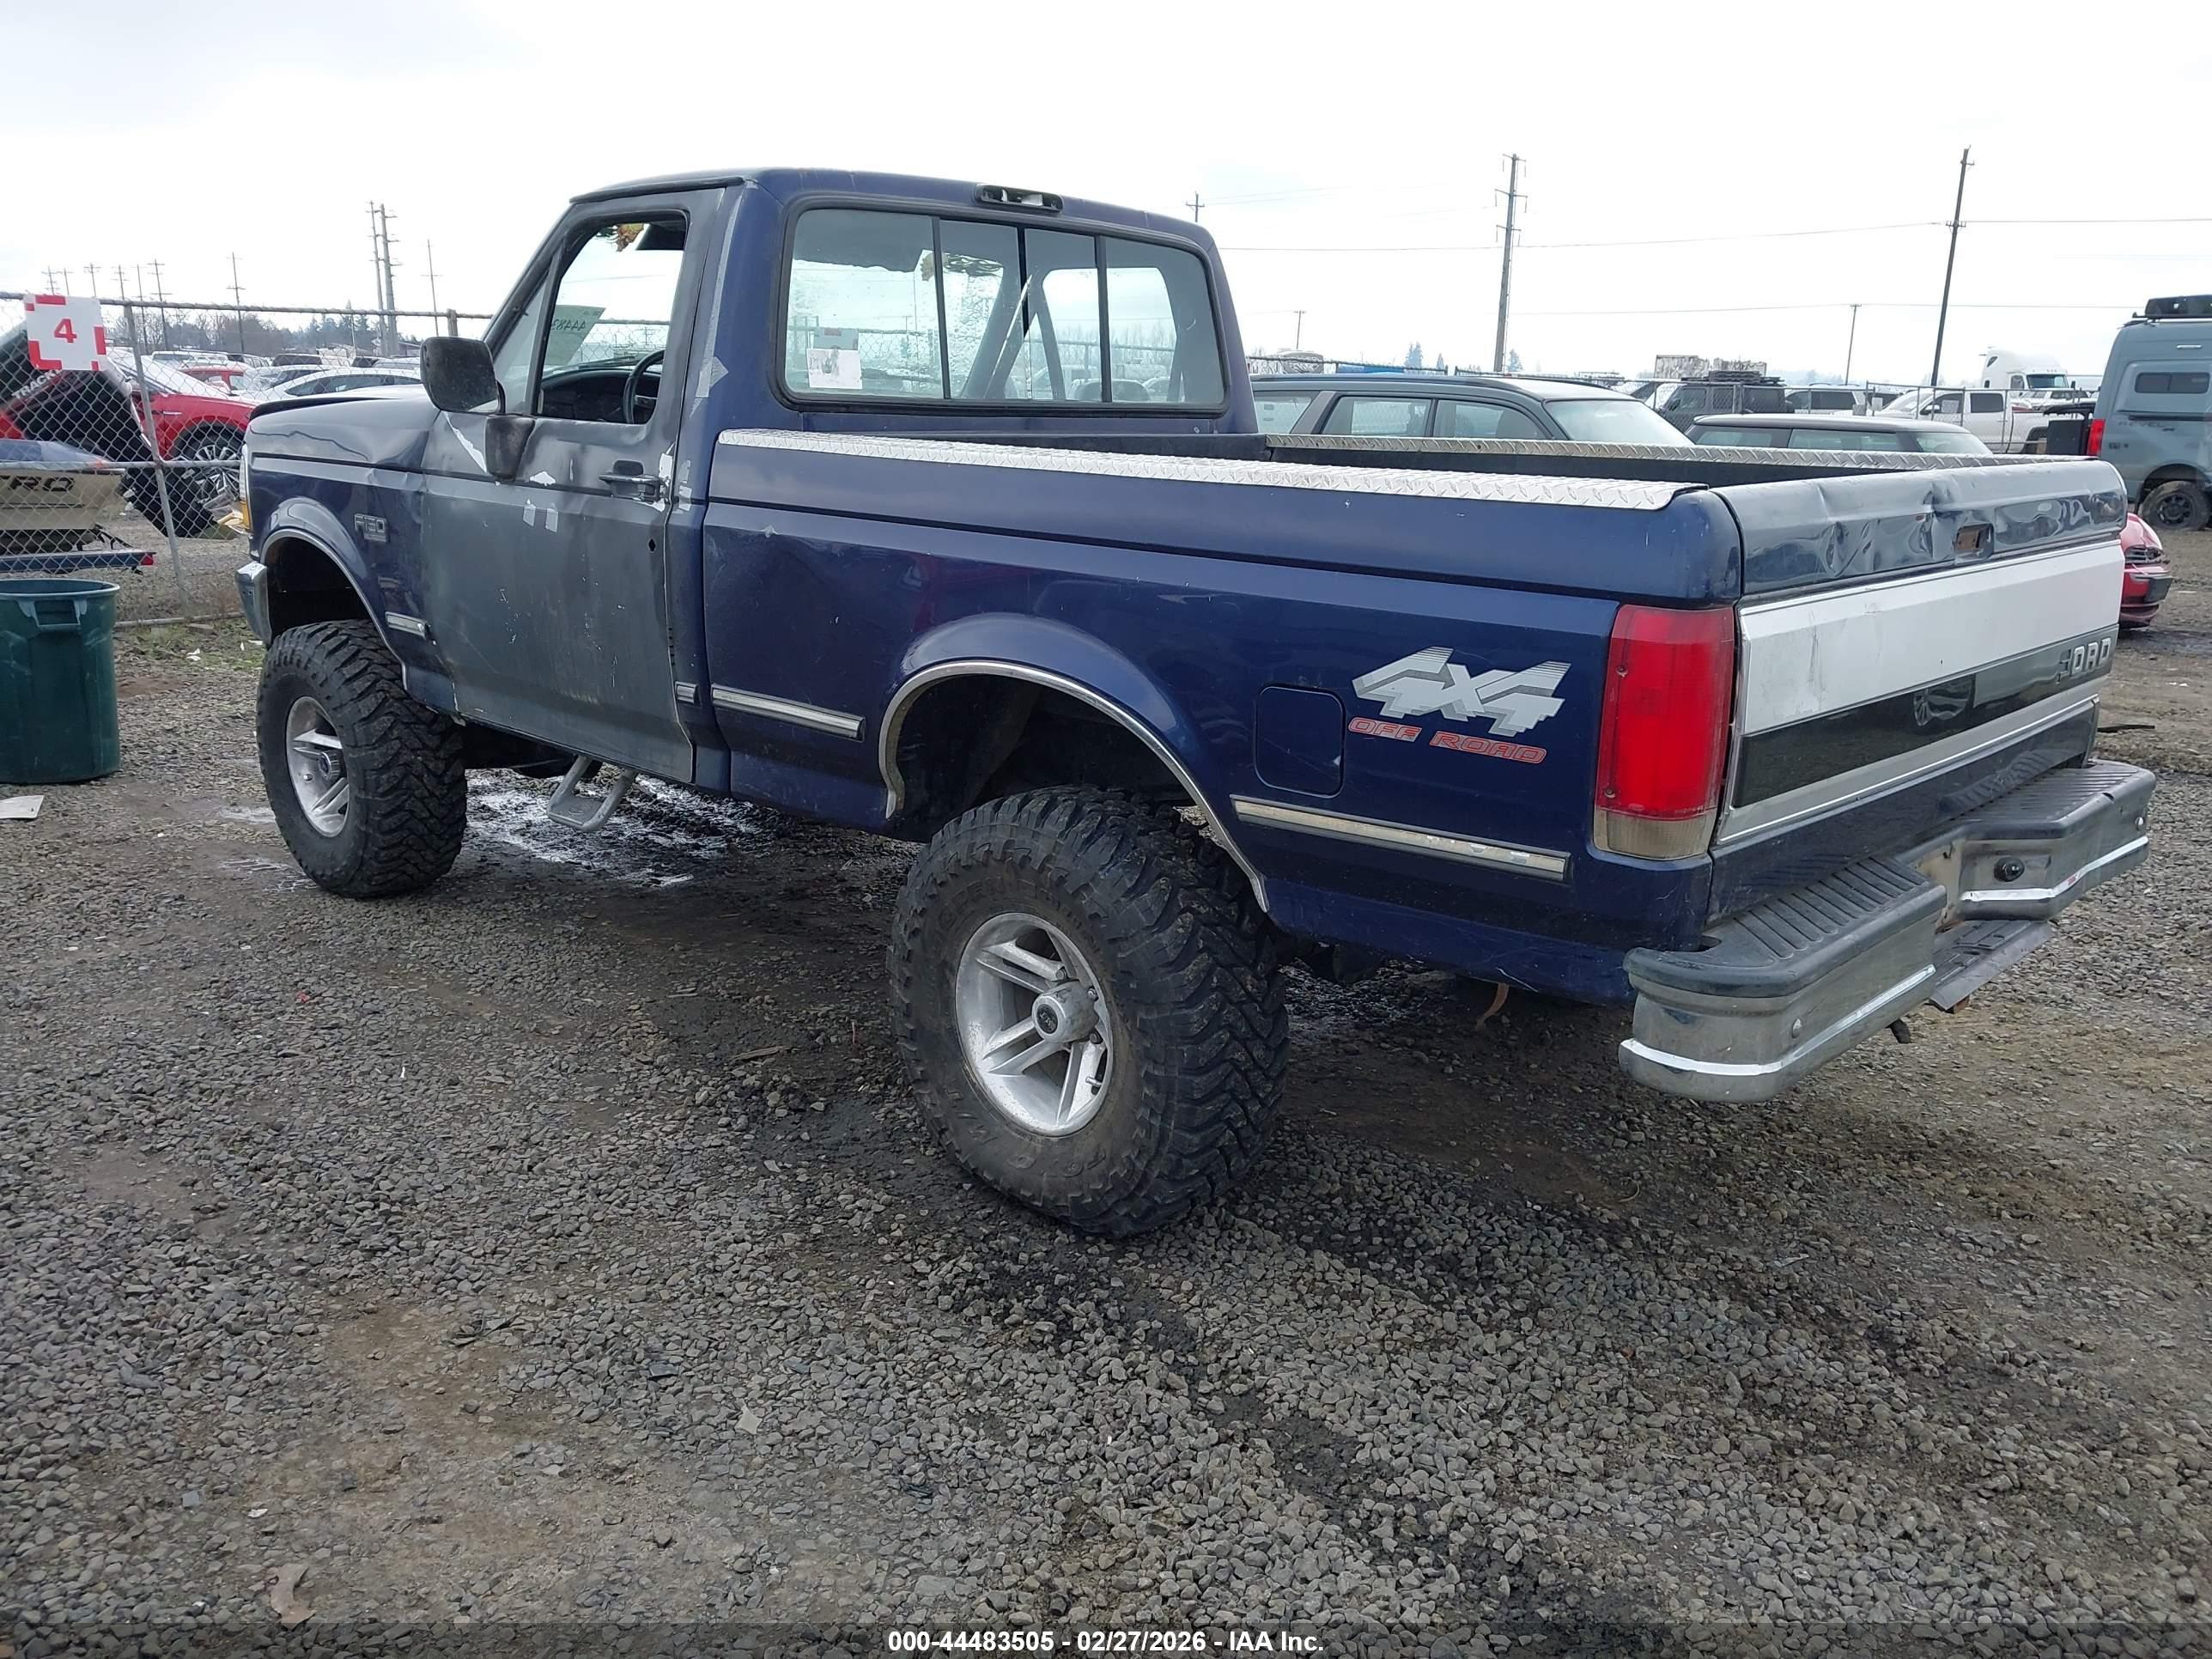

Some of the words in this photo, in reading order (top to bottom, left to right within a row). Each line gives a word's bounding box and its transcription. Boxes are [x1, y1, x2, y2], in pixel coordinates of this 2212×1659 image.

[54, 319, 77, 343] 4
[1348, 716, 1423, 743] OFF
[1429, 731, 1547, 764] ROAD
